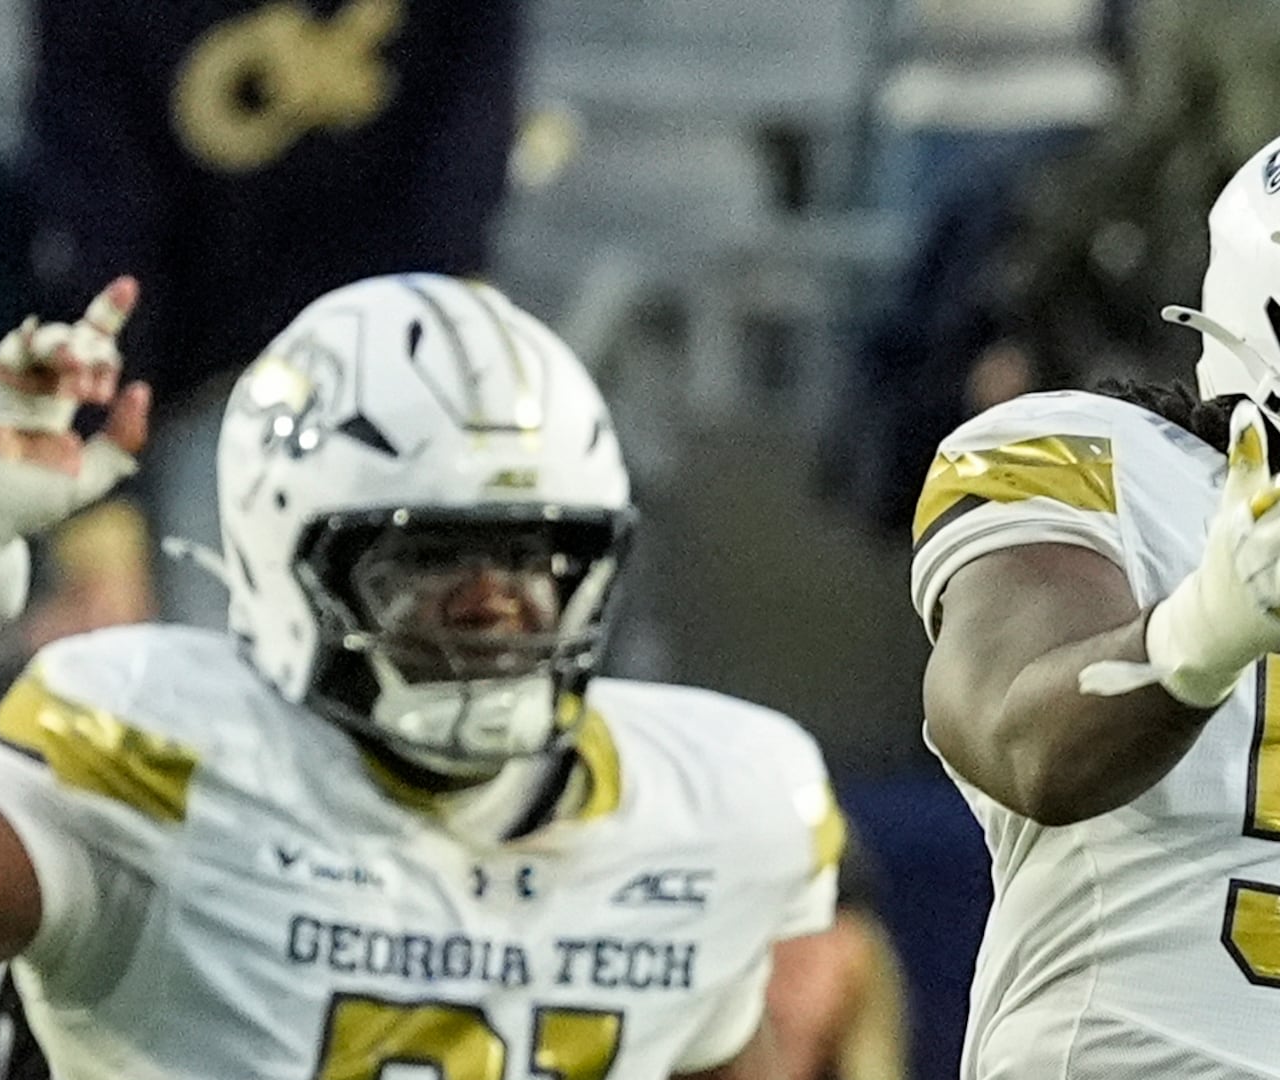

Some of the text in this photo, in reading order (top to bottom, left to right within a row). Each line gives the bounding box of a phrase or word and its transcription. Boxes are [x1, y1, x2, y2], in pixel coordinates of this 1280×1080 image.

[611, 868, 717, 903] ACC
[287, 914, 697, 989] GEORGIA TECH
